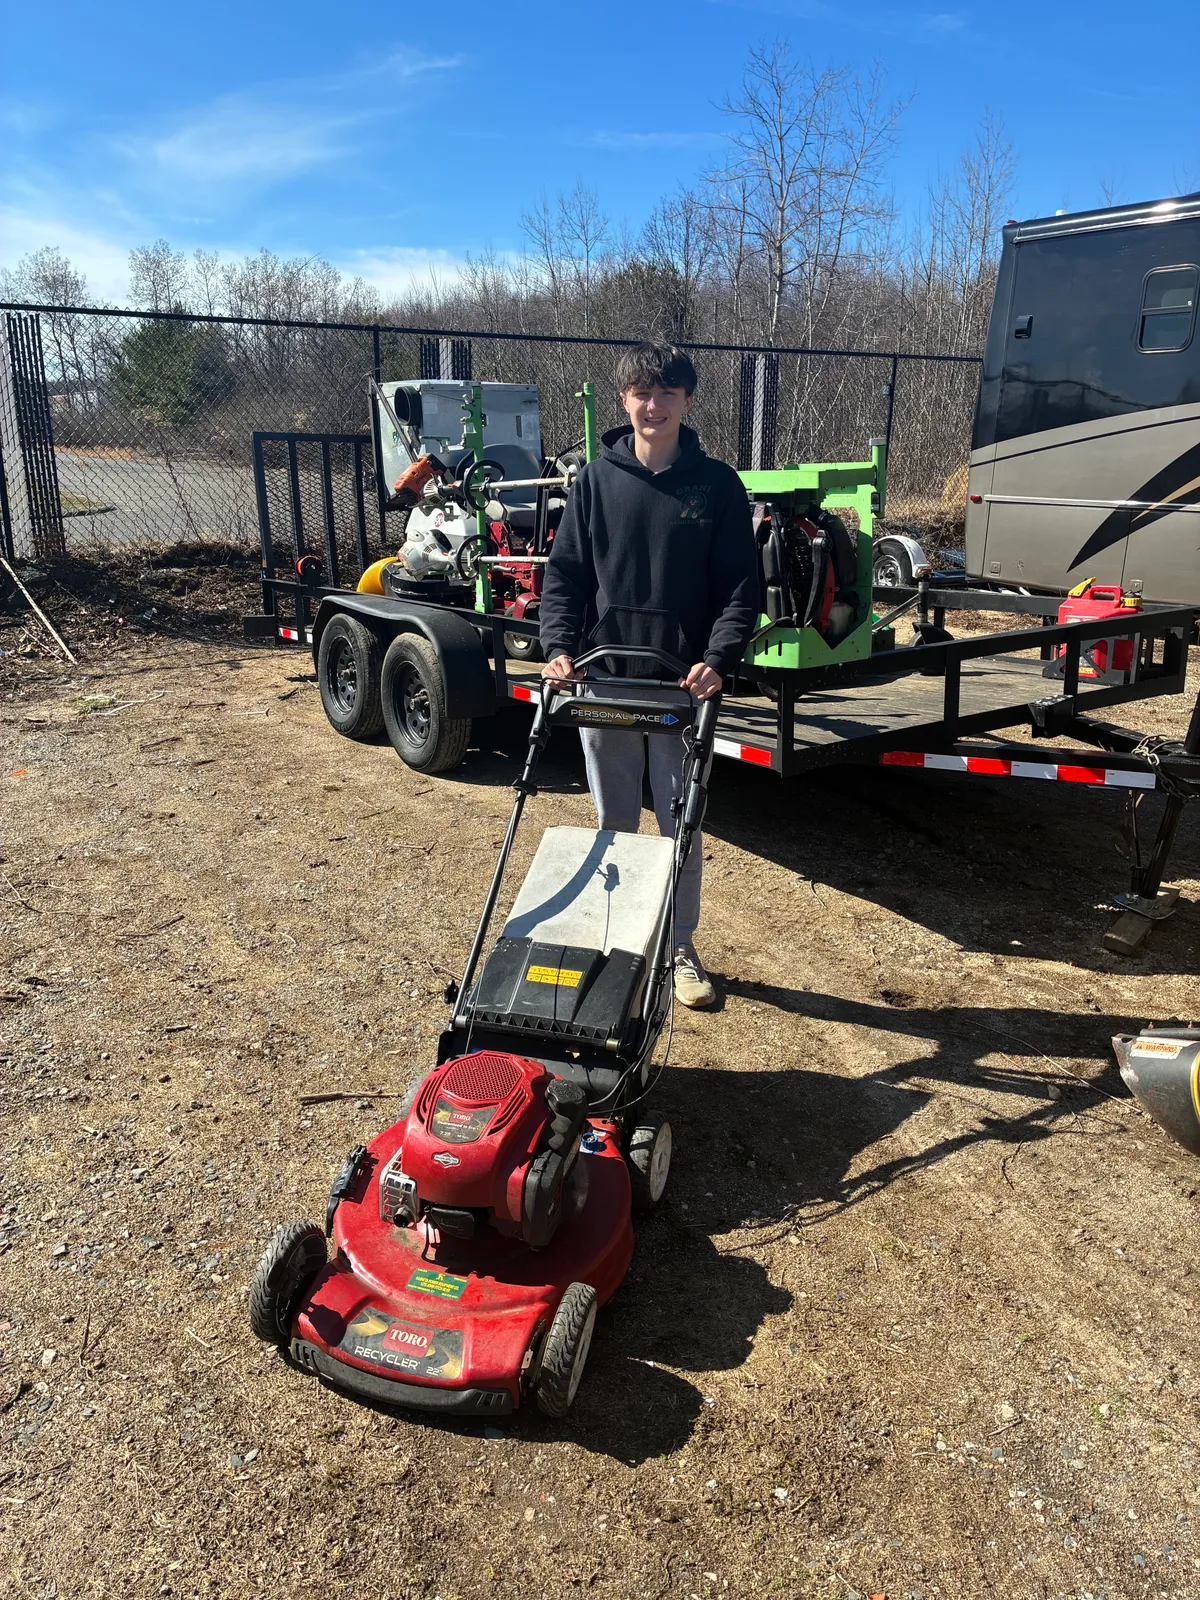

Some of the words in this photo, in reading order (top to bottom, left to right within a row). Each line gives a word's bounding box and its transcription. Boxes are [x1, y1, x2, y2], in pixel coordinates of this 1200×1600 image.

[570, 708, 629, 720] PERSONAL
[633, 713, 661, 723] PACE
[1145, 1044, 1177, 1052] WARNING
[390, 1328, 428, 1348] TORO
[354, 1345, 419, 1371] RECYCLER
